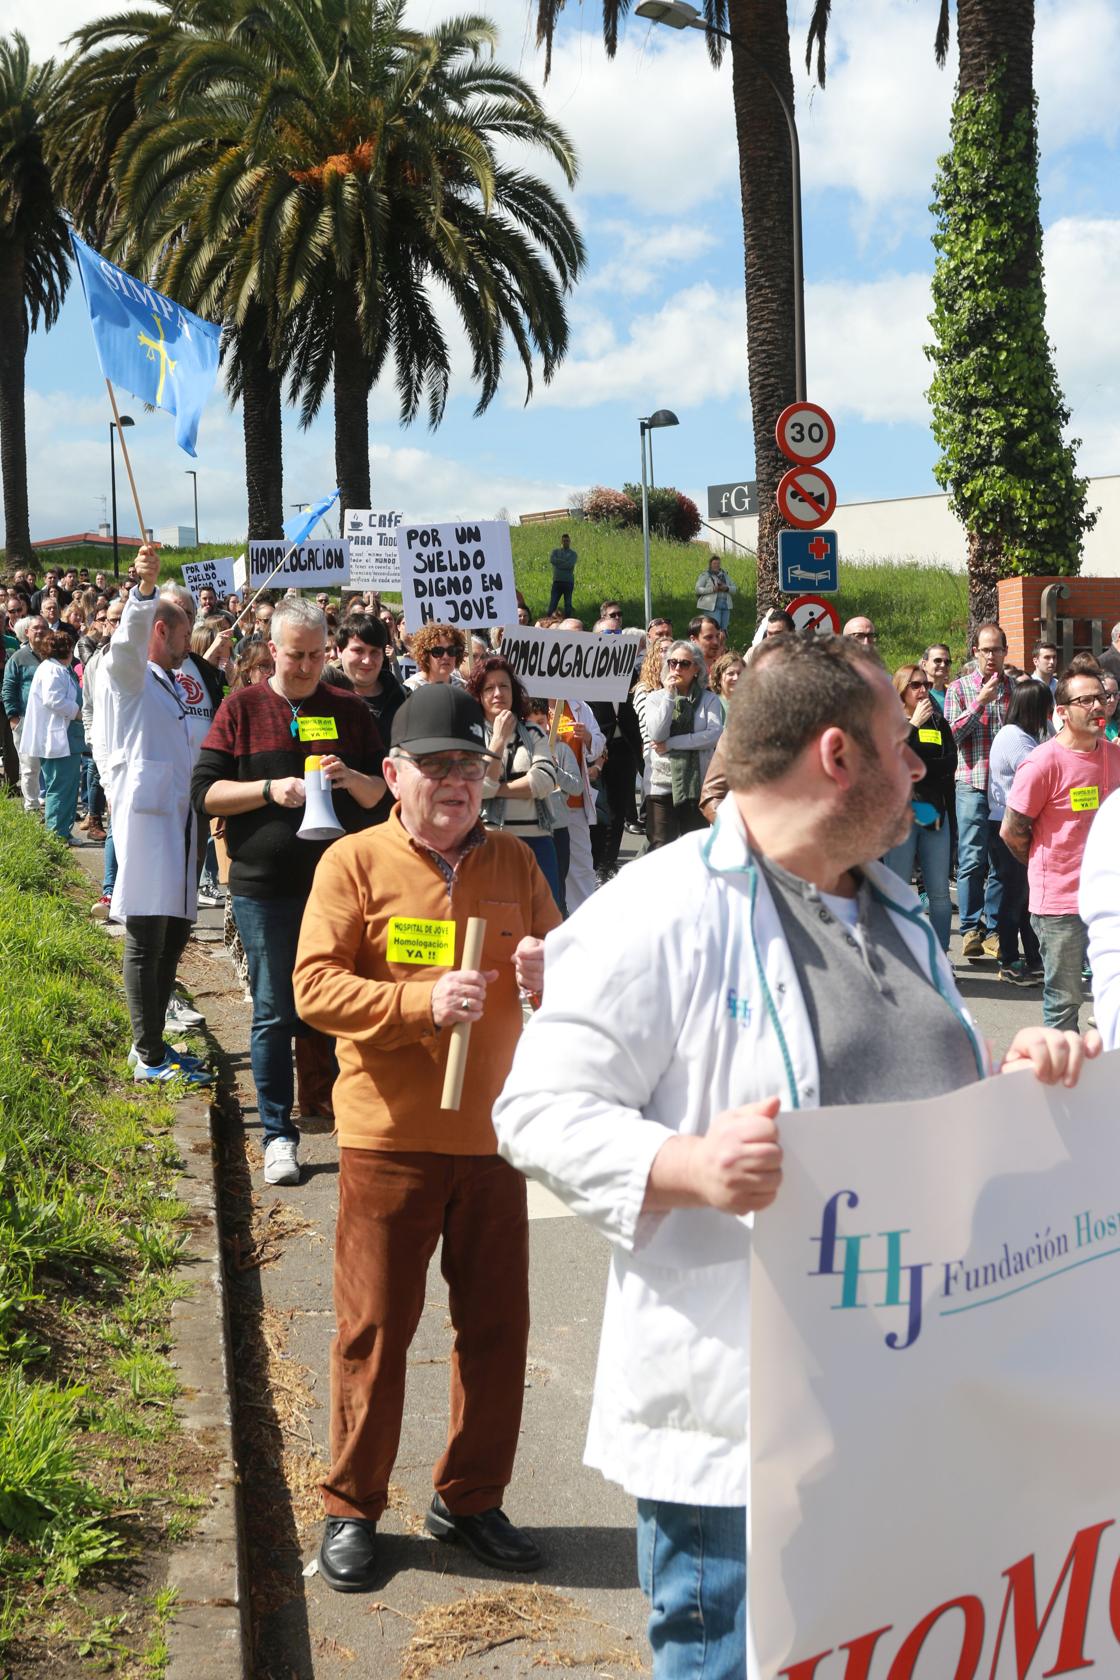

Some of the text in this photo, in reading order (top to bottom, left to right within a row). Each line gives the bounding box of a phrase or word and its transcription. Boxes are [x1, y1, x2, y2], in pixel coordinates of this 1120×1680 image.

[100, 261, 192, 342] SIMPA
[790, 422, 824, 443] 30
[720, 485, 751, 513] fG
[347, 535, 373, 546] PARA
[406, 526, 481, 550] POR UN
[185, 562, 216, 574] POR UN
[250, 543, 344, 575] HOMOLOGACION
[413, 549, 485, 574] SUELDO
[188, 572, 217, 583] SUELDO
[217, 579, 227, 587] EN
[412, 572, 503, 598] DIGNO EN
[420, 595, 498, 625] H. JOVE
[394, 922, 449, 935] HOSPITAL DE JOVE
[393, 937, 449, 949] Homologación
[406, 949, 436, 960] YA !!
[807, 1190, 933, 1350] fHJ
[941, 1226, 1069, 1298] Fundación
